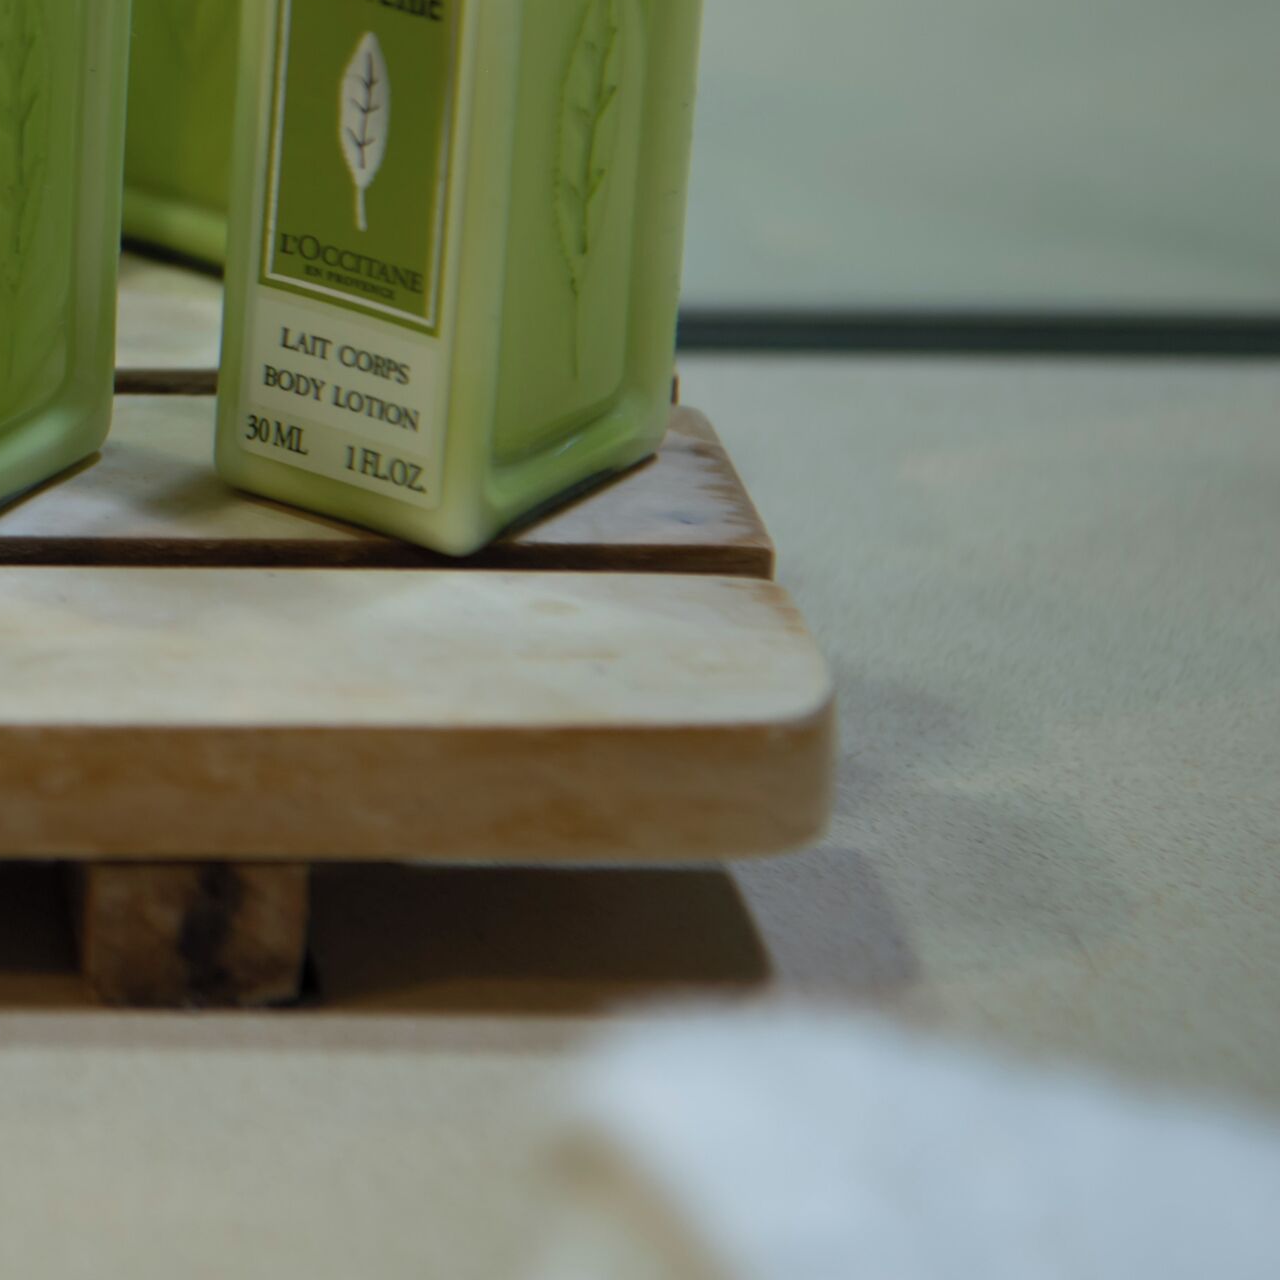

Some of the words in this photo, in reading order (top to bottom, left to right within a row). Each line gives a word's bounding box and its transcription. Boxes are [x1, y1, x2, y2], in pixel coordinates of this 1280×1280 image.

[280, 326, 333, 360] LAIT
[338, 344, 411, 386] CORPS
[263, 364, 326, 402] BODY
[332, 384, 421, 433] LOTION
[246, 414, 271, 444] 30
[273, 421, 309, 456] ML
